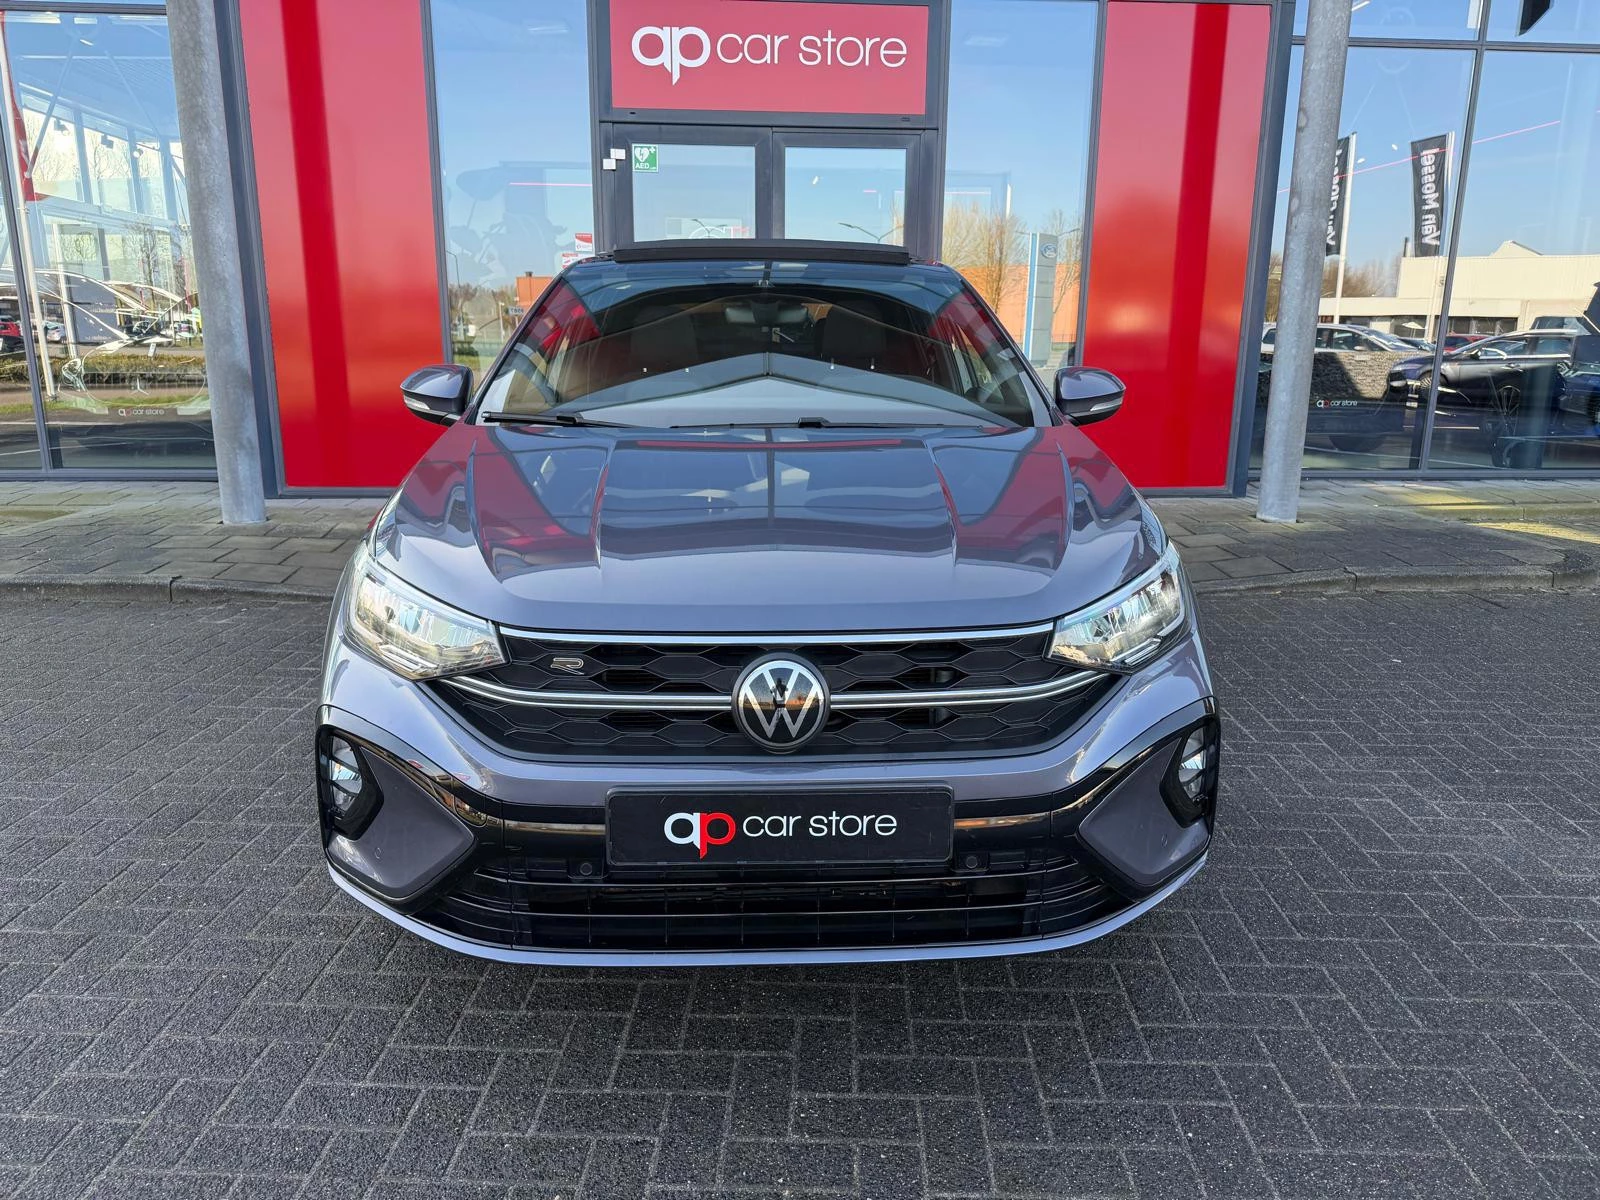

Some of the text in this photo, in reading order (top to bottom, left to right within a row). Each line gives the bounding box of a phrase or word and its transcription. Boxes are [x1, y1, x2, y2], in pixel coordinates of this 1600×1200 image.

[717, 33, 788, 65] car
[799, 31, 907, 67] store
[743, 815, 801, 837] car
[809, 810, 897, 837] store
